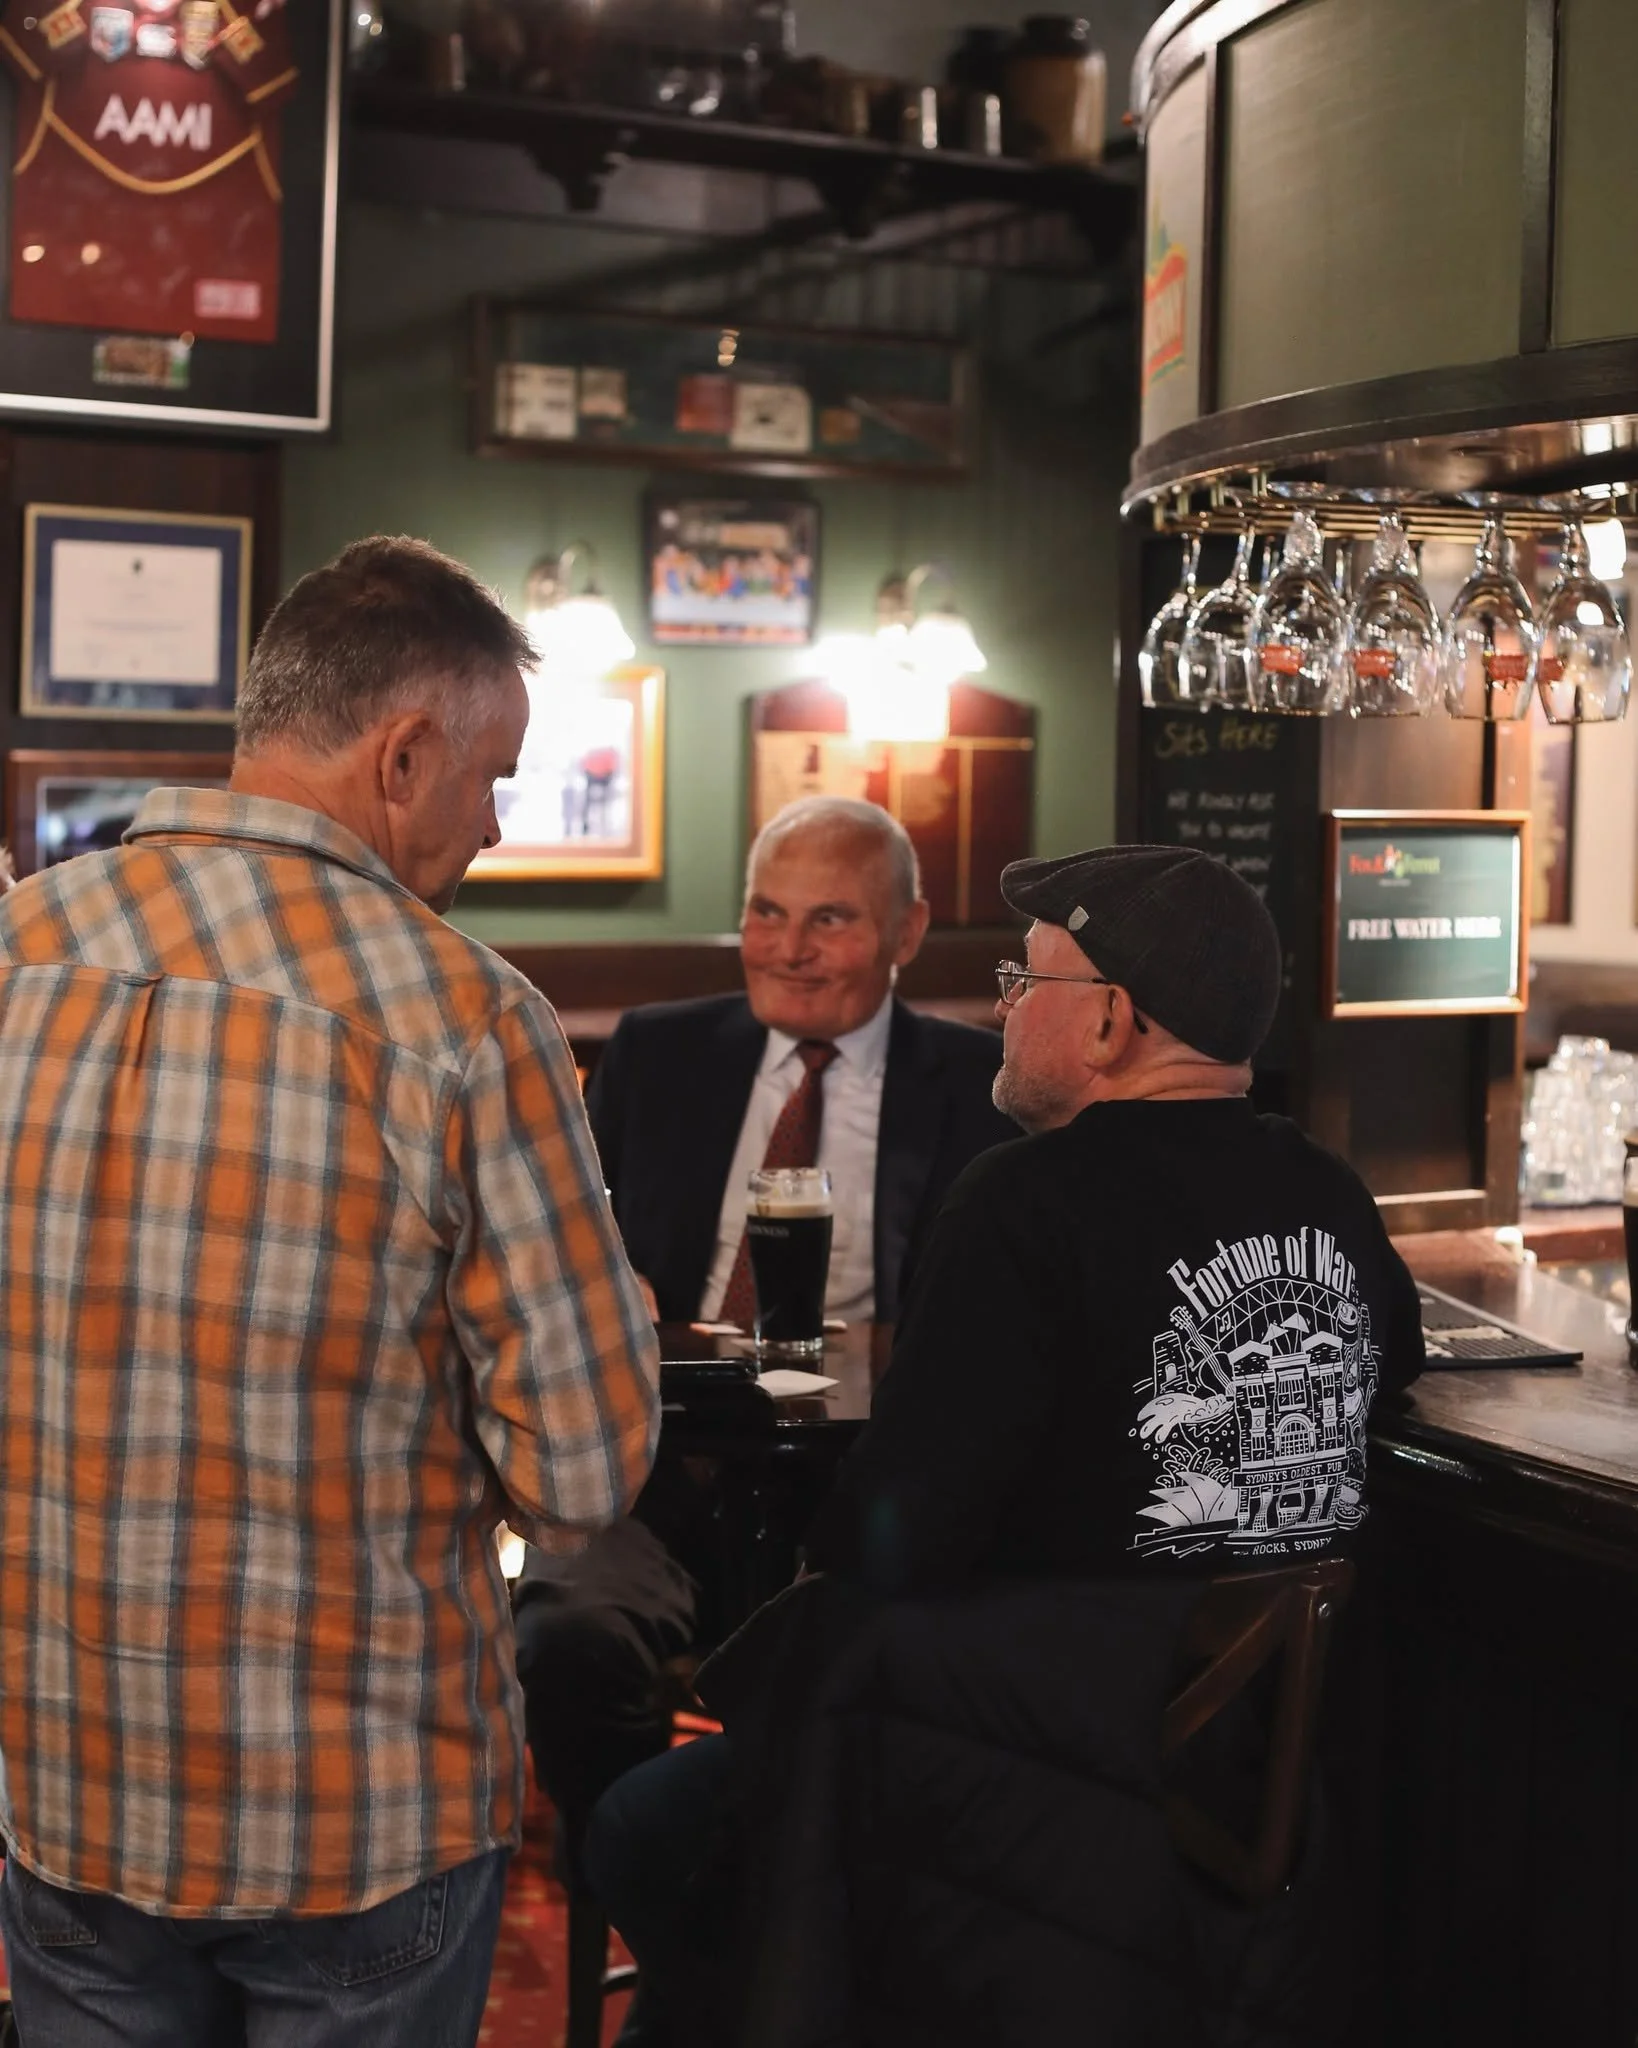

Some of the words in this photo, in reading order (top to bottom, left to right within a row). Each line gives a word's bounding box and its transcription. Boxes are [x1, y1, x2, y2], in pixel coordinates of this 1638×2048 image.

[94, 93, 212, 151] AAMI
[1348, 918, 1392, 940] FREE
[1394, 917, 1452, 940] WATER
[1167, 1234, 1281, 1320] Fortune
[1285, 1226, 1308, 1278] of
[1314, 1228, 1355, 1299] War
[1246, 1470, 1287, 1485] SYDNEY'S
[1291, 1465, 1322, 1479] OLDEST
[1327, 1461, 1342, 1473] PUB
